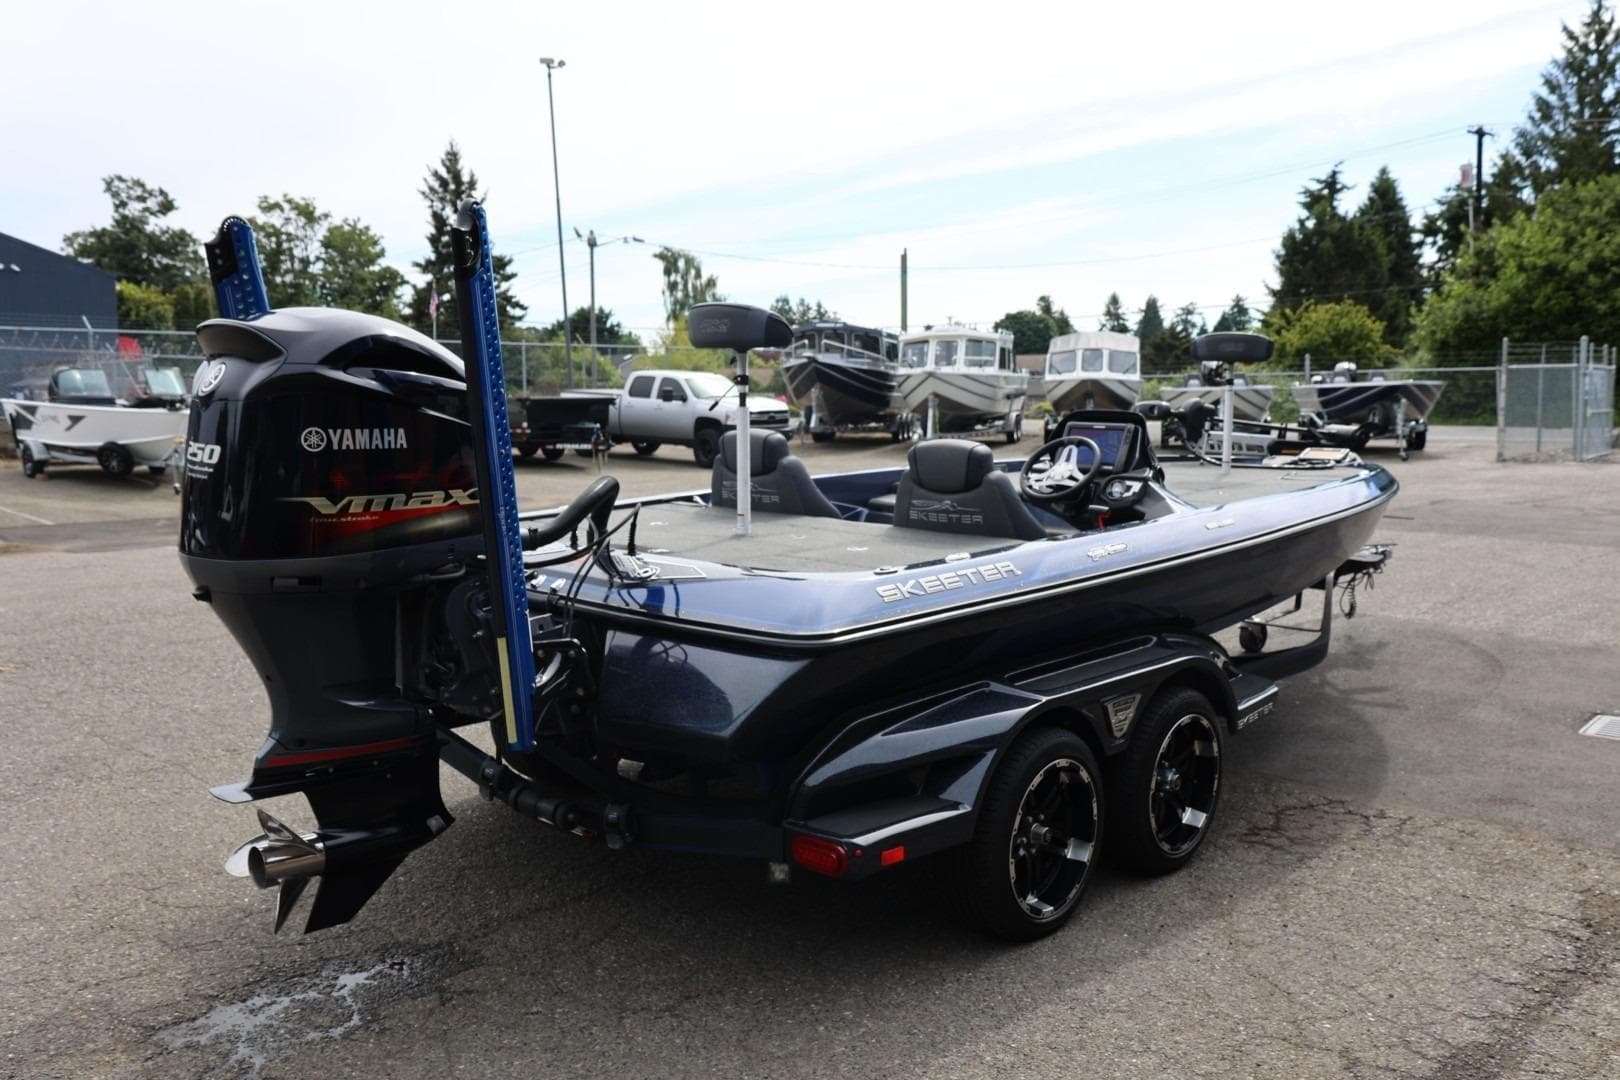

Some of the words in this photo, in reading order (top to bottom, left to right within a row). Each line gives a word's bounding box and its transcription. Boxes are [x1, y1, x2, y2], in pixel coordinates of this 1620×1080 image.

[328, 428, 407, 450] YAMAHA
[910, 510, 983, 525] SKEETER
[876, 561, 1022, 602] SKEETER
